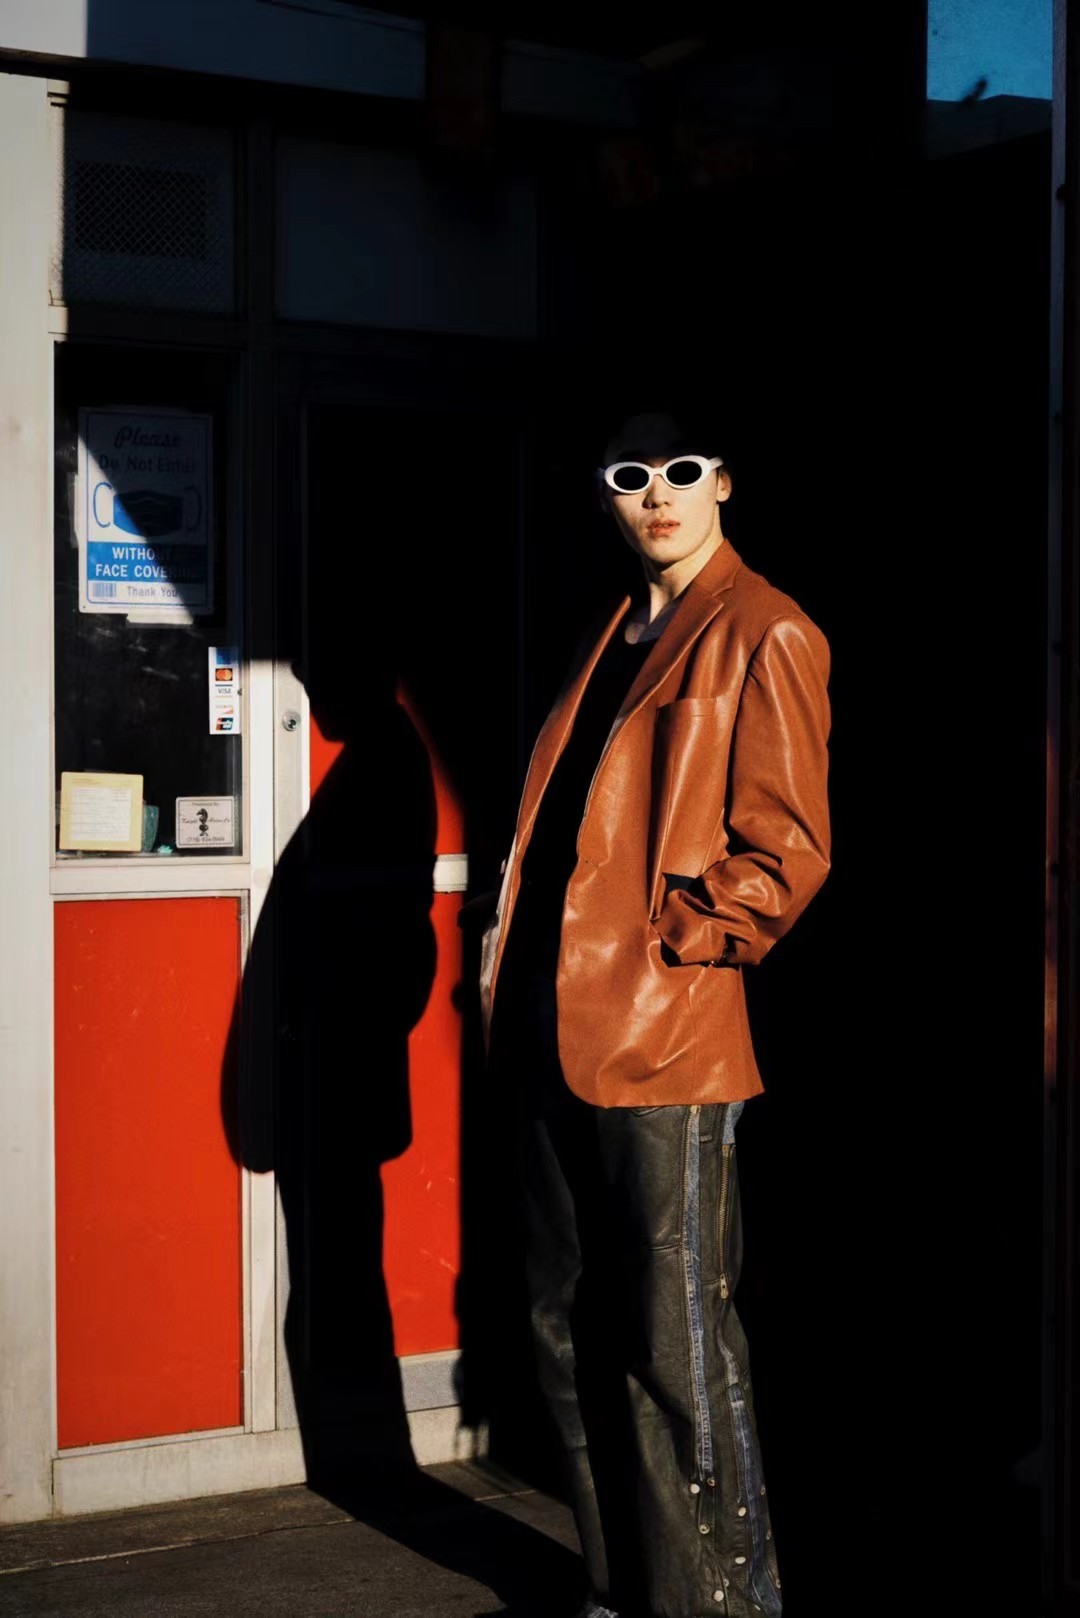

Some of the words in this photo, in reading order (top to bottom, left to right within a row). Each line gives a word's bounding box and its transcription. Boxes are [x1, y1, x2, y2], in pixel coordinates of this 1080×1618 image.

[113, 425, 181, 449] Please
[99, 454, 119, 470] Do
[127, 456, 153, 471] Not
[95, 564, 128, 577] FACE
[127, 586, 156, 597] Thank
[160, 587, 178, 598] You
